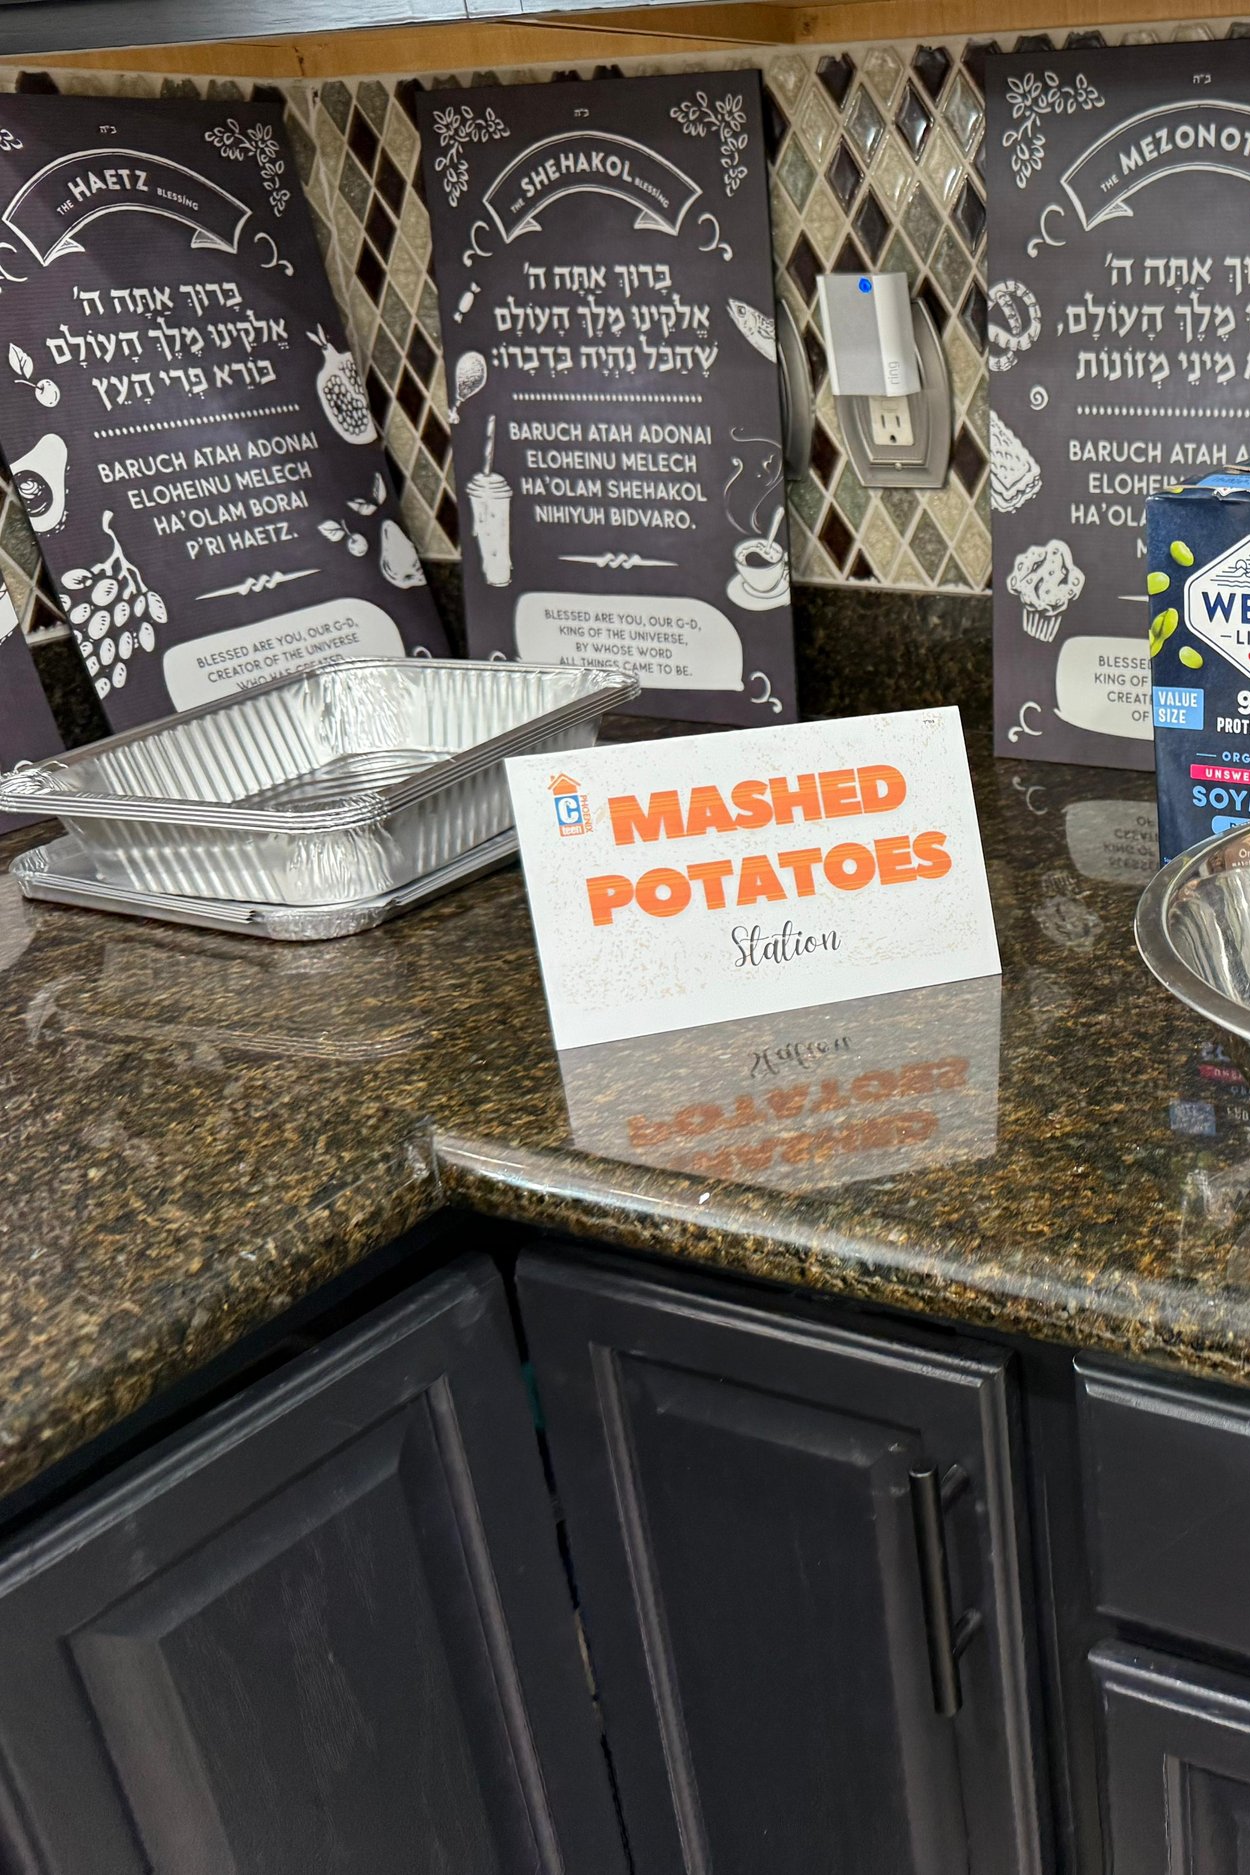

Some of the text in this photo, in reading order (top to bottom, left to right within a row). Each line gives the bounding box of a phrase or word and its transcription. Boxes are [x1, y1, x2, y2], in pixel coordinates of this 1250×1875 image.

[57, 200, 74, 215] THE
[67, 169, 149, 201] HAETZ
[510, 198, 525, 214] THE
[520, 151, 633, 198] SHEHAKOL
[1100, 174, 1119, 193] THE
[887, 360, 900, 385] ring
[509, 422, 711, 444] BARUCH ATAH ADONAI
[97, 432, 317, 482] BARUCH ATAH ADONAI
[527, 450, 696, 472] ELOHEINU MELECH
[1069, 440, 1161, 463] BARUCH
[1170, 443, 1227, 465] ATAH
[127, 462, 311, 509] ELOHEINU MELECH
[521, 476, 707, 501] HA'OLAM SHEHAKOL
[153, 490, 308, 535] HA'OLAM BORAI
[535, 505, 695, 529] NIHIYUH BIDVARO.
[186, 522, 298, 559] P'RI HAETZ.
[544, 609, 701, 630] BLESSED ARE YOU, OUR G-D,
[196, 617, 358, 668] BLESSED ARE YOU, OUR G-D,
[559, 625, 687, 646] KING OF THE UNIVERSE,
[207, 659, 262, 683] CREATOR
[263, 654, 279, 667] OF
[281, 647, 303, 660] THE
[305, 632, 359, 655] UNIVERSE
[575, 642, 672, 659] BY WHOSE WORD
[623, 661, 653, 674] CAME
[657, 664, 672, 675] TO
[676, 665, 693, 677] BE.
[1094, 673, 1148, 688] KING OF
[1158, 691, 1198, 707] VALUE
[1131, 710, 1149, 722] OF
[1158, 708, 1186, 724] SIZE
[558, 797, 579, 824] C
[580, 795, 593, 833] PHOENIX
[607, 764, 907, 846] MASHED
[585, 831, 953, 927] POTATOES
[731, 920, 841, 968] Station
